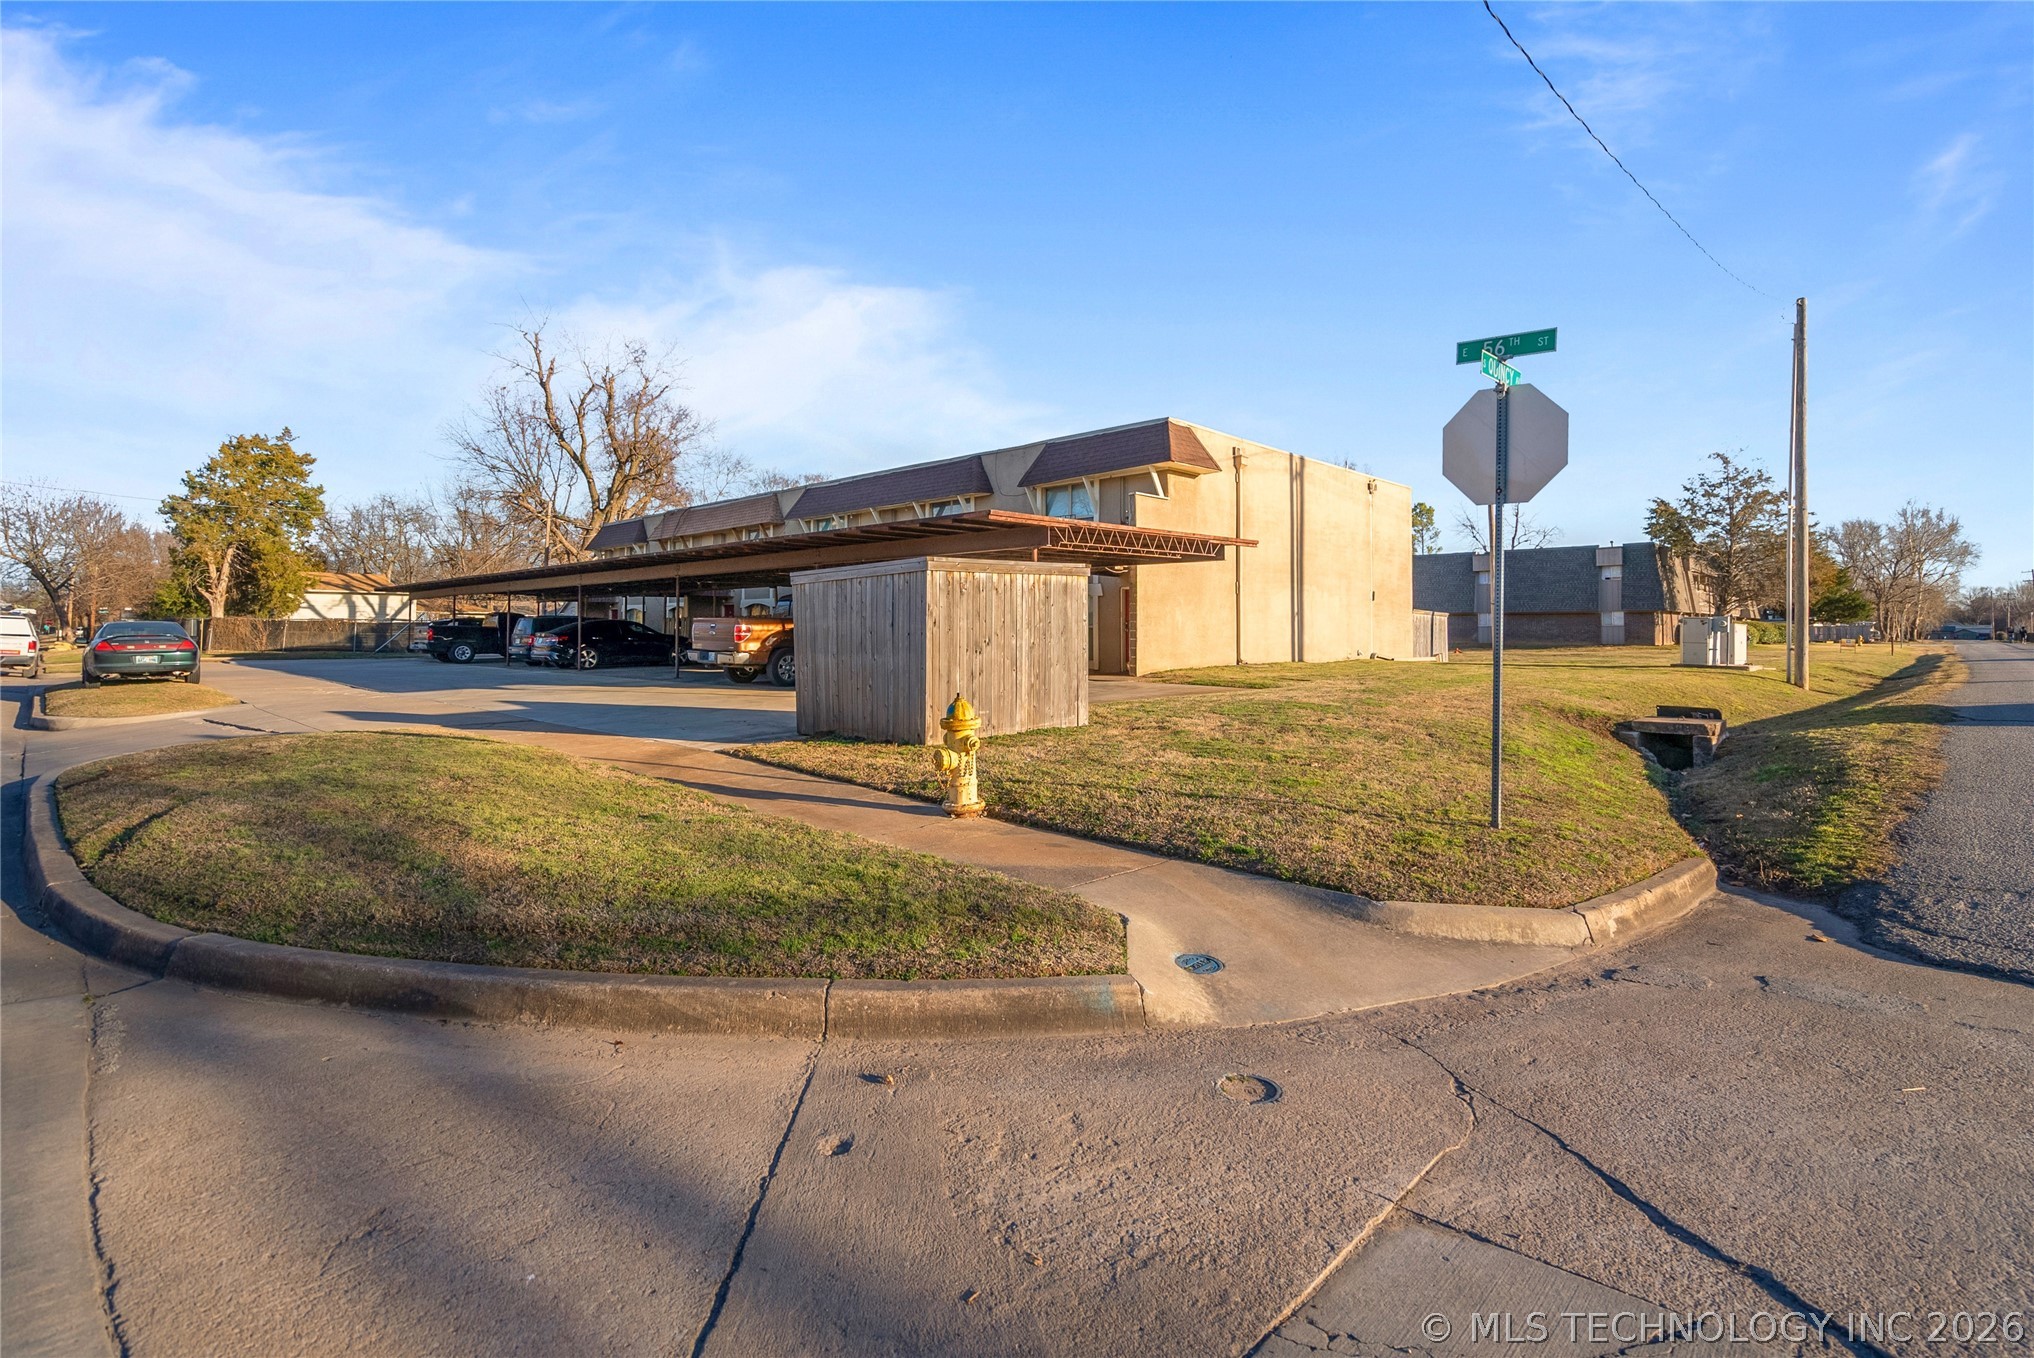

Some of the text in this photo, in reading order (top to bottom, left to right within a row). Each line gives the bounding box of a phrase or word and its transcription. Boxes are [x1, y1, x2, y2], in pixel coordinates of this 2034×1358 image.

[1462, 348, 1468, 357] E
[1537, 336, 1549, 347] ST
[1488, 357, 1515, 386] QUINCY
